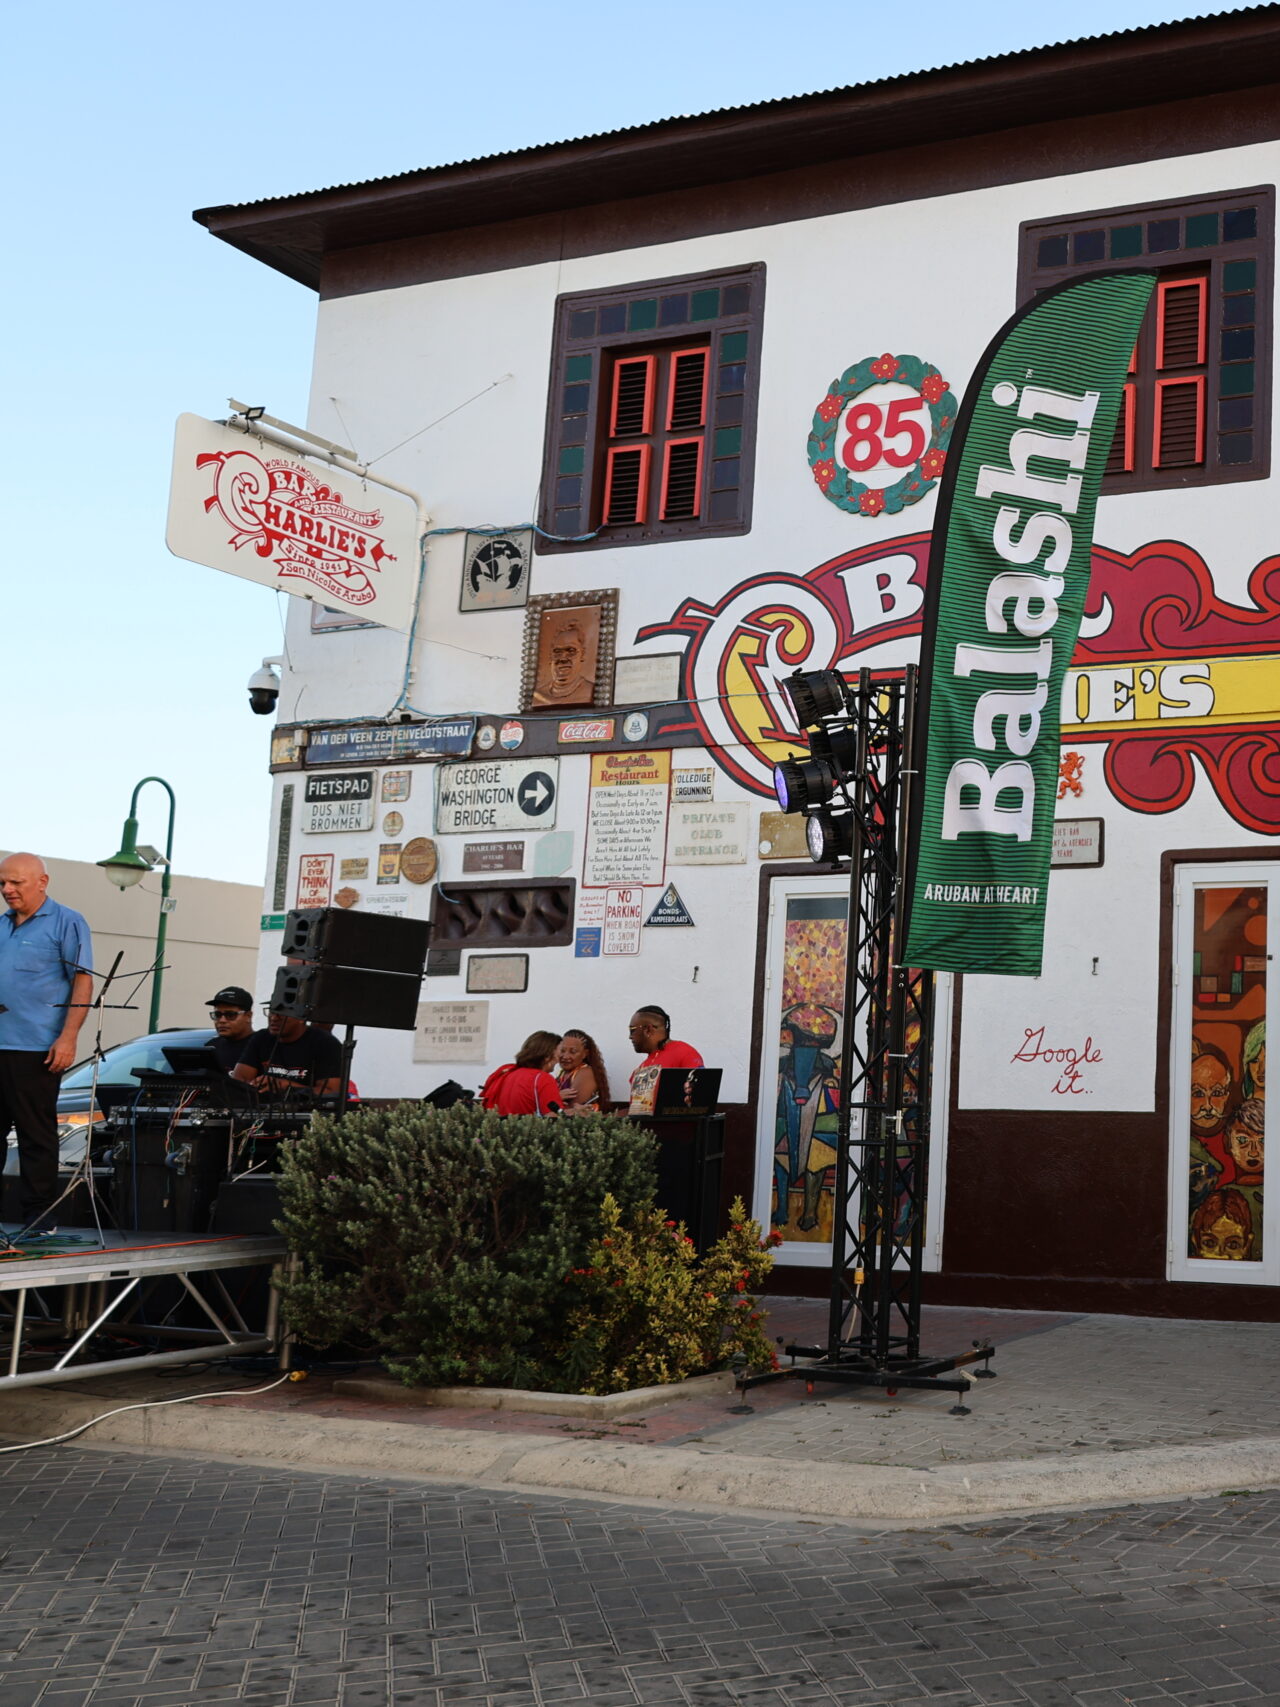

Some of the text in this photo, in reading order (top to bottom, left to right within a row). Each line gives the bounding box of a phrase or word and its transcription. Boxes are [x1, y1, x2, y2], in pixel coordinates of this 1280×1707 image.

[842, 396, 928, 472] 85
[265, 459, 320, 485] WORLD FAMOUS
[273, 471, 317, 500] BAR
[314, 503, 375, 526] RESTAURANT
[285, 544, 342, 571] Since 1941
[285, 563, 373, 601] San Nicolas Aruba
[941, 380, 1100, 842] Balashi
[311, 734, 328, 745] VAN
[330, 733, 347, 744] DER
[350, 731, 373, 743] VEEN
[455, 768, 501, 785] GEORGE
[600, 769, 660, 781] Restaurant
[673, 773, 712, 783] VOLLEDIGE
[308, 779, 369, 796] FIETSPAD
[441, 787, 515, 807] WASHINGTON
[312, 802, 363, 817] DUS NIET
[310, 817, 361, 831] BROMMEN
[454, 809, 497, 826] BRIDGE
[682, 812, 736, 824] PRIVATE
[690, 829, 722, 840] CLUB
[464, 843, 524, 853] CHARLIE'S BAR
[674, 844, 738, 857] ENTRANCE
[302, 877, 329, 889] THINK
[309, 889, 319, 897] OF
[617, 890, 632, 903] NO
[924, 883, 1040, 904] ARUBAN AT HEART
[298, 897, 328, 905] PARKING
[607, 905, 641, 918] PARKING
[607, 920, 640, 930] WHEN ROAD
[650, 915, 688, 923] KAMPEERPLAATS
[618, 932, 635, 940] SNOW
[608, 943, 635, 952] COVERED
[1010, 1026, 1104, 1075] Google
